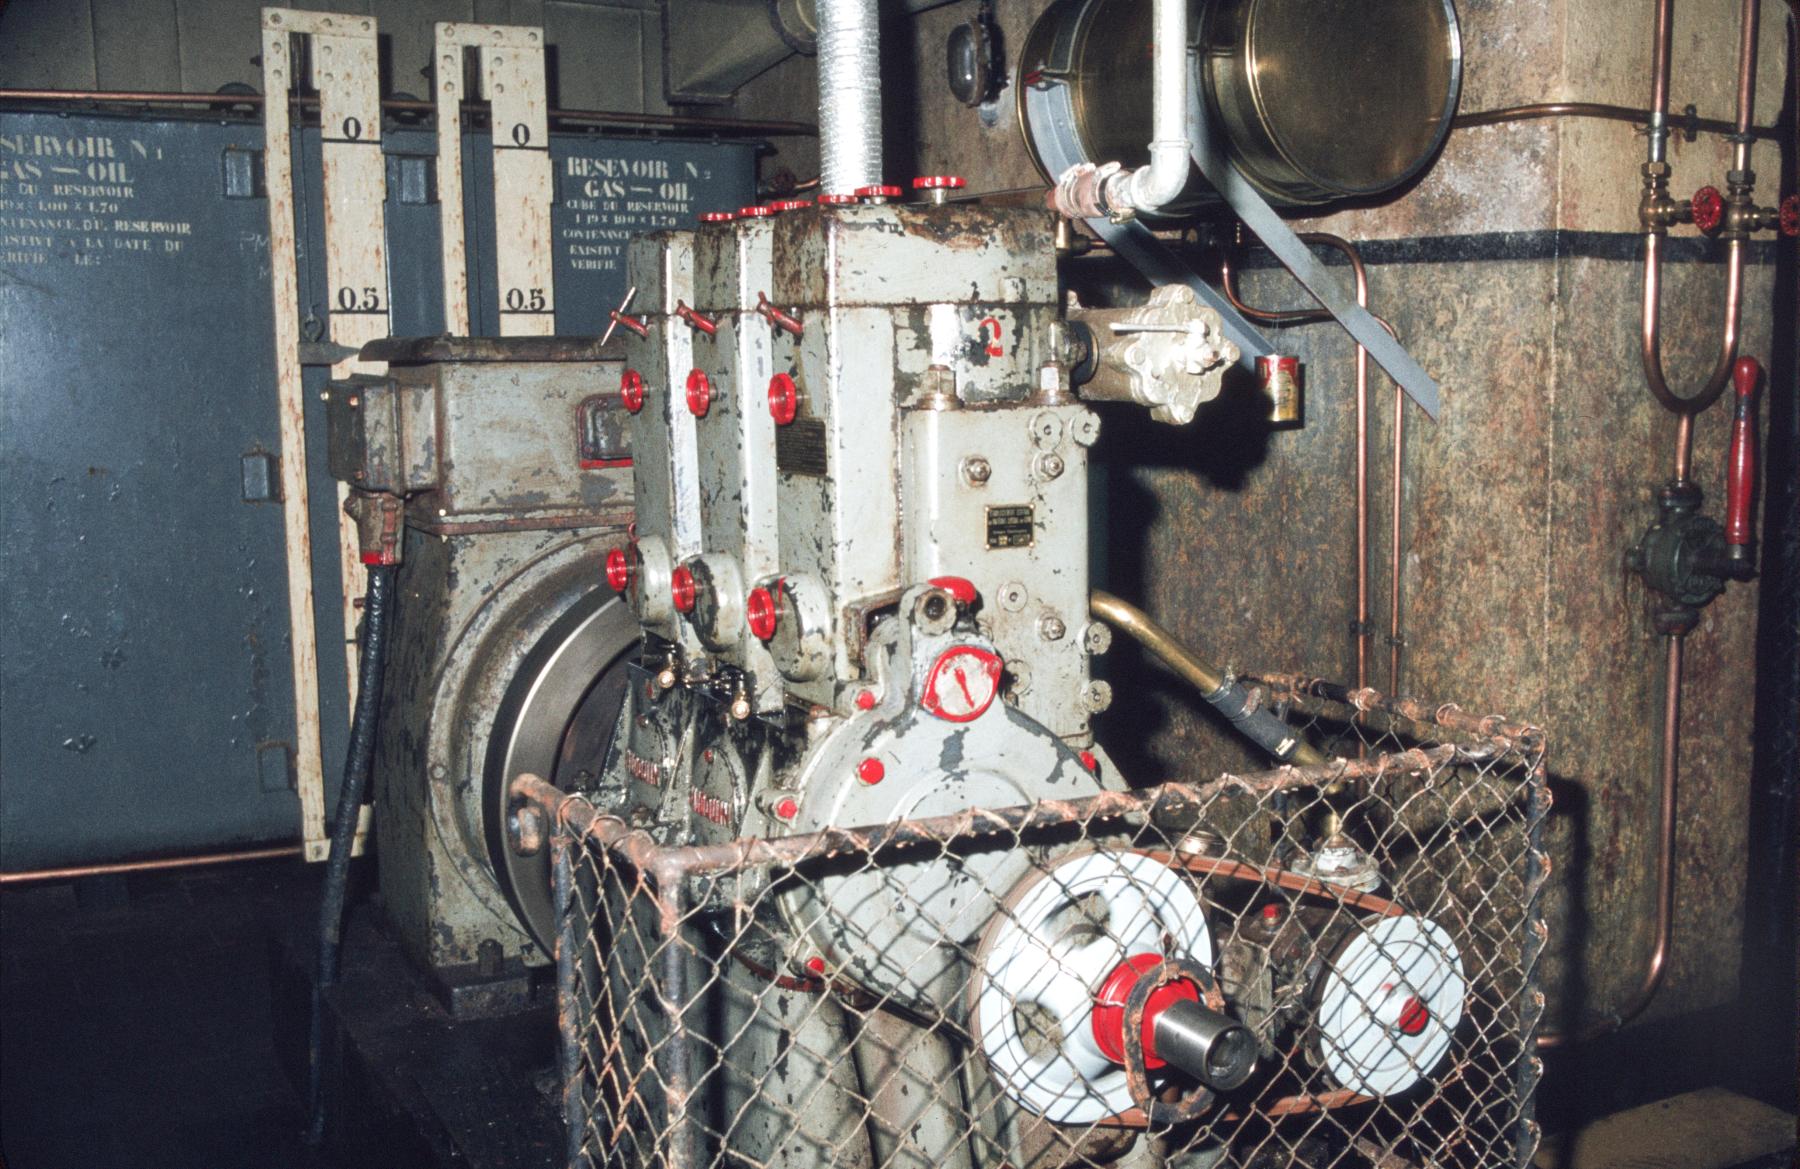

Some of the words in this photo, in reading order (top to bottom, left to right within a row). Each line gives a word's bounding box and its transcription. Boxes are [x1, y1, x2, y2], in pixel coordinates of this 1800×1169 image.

[342, 116, 362, 140] 0
[512, 122, 531, 147] 0
[87, 162, 135, 183] OIL
[53, 184, 135, 198] RESERVOIR
[584, 179, 626, 199] GAS
[659, 182, 695, 201] OIL
[566, 199, 597, 211] CUBE
[626, 201, 689, 213] RESERVOIR
[338, 286, 380, 311] 0.5
[506, 287, 546, 311] 0.5
